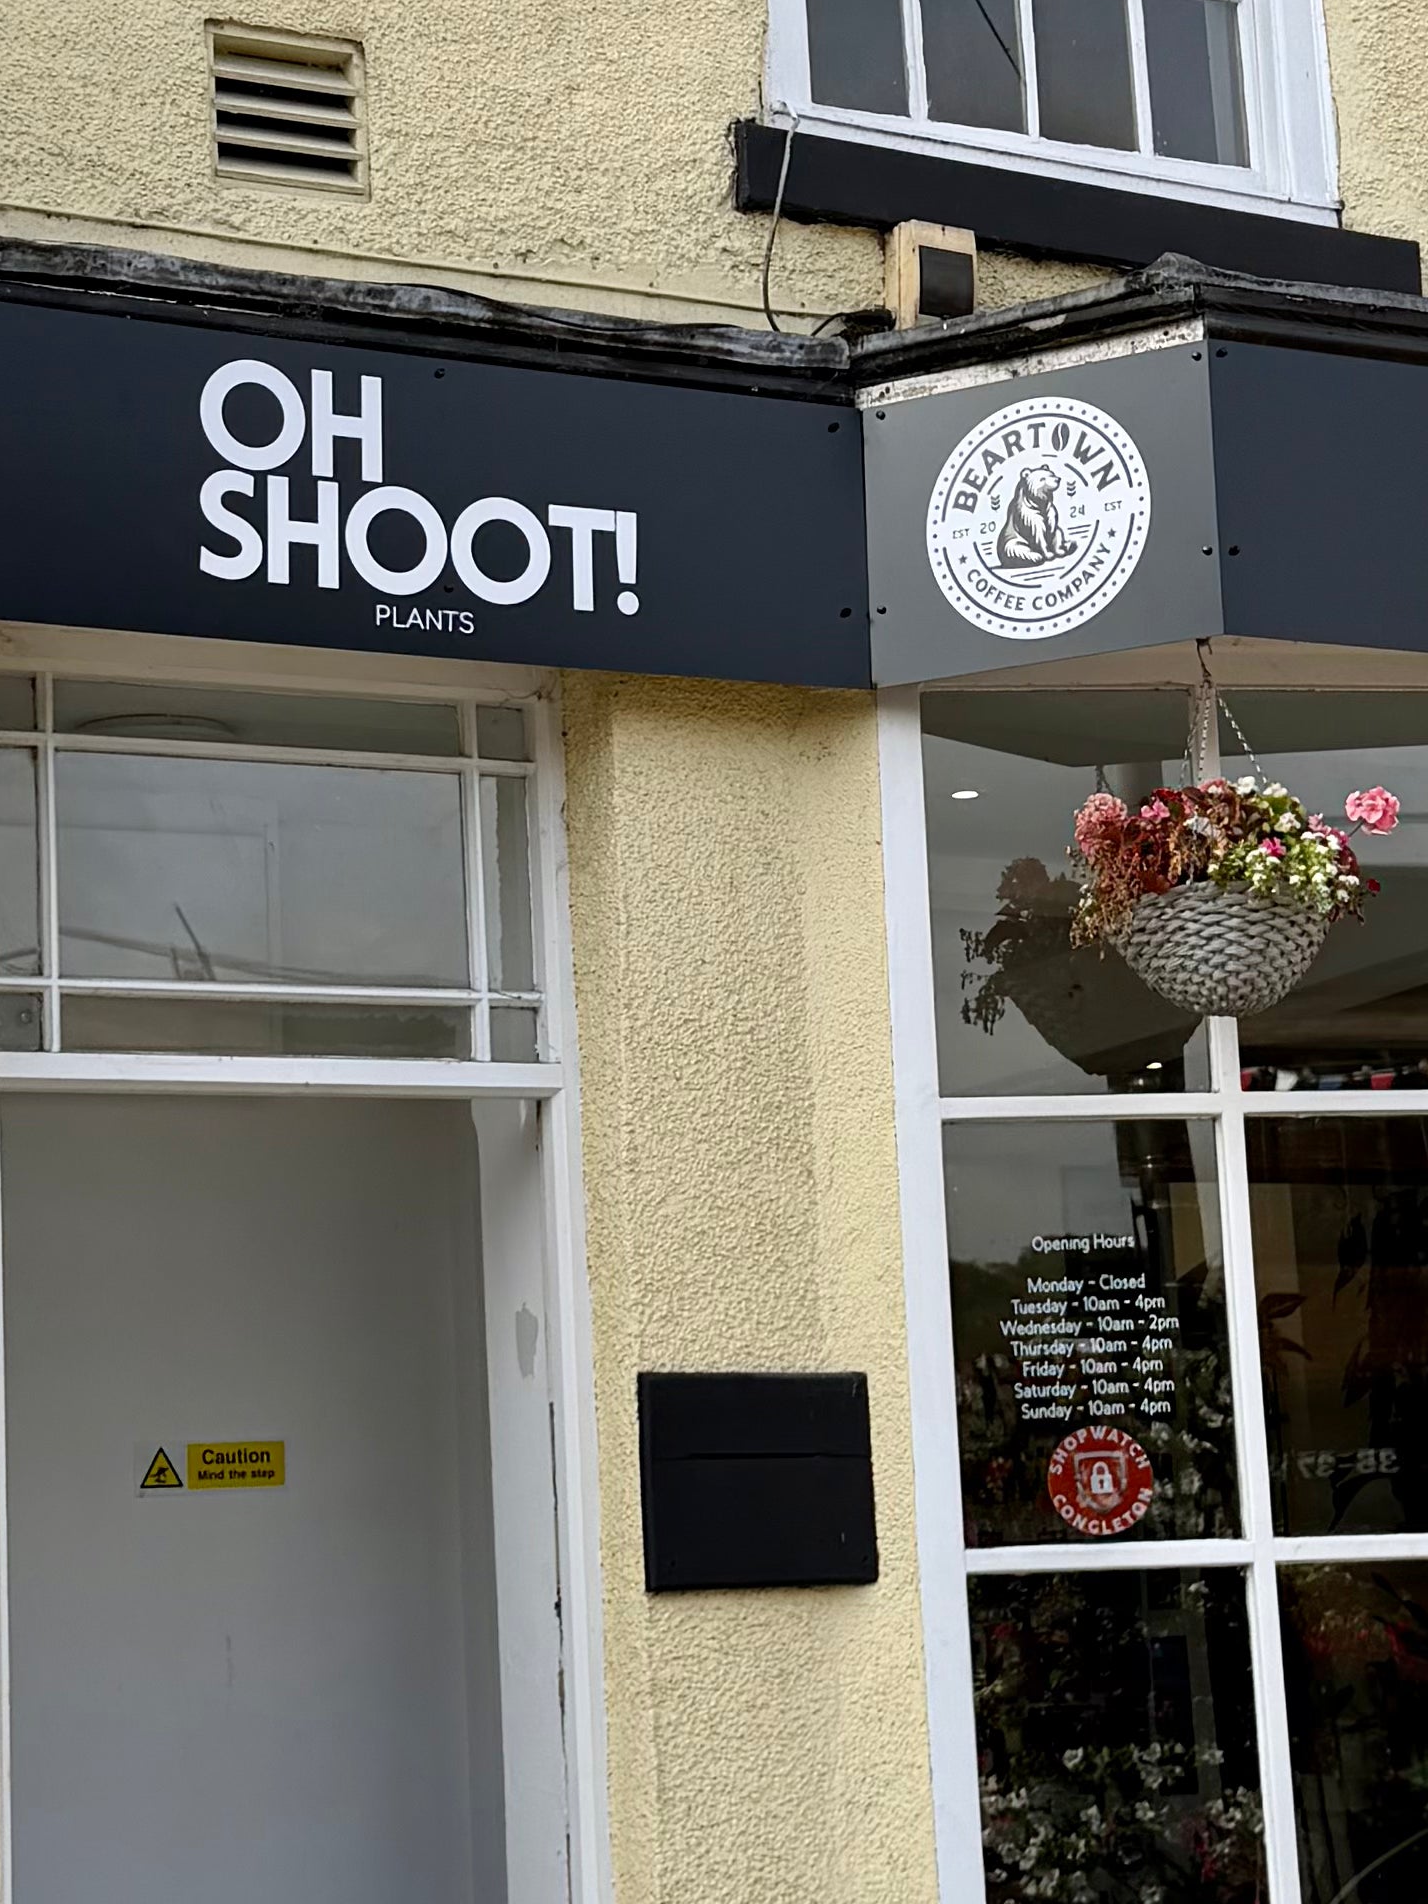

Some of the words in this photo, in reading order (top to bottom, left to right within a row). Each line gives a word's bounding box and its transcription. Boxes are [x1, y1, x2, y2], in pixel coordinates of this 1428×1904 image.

[199, 359, 383, 483] OH
[952, 422, 1121, 514] BEARTOWN
[980, 521, 996, 534] 20
[1069, 504, 1086, 518] 24
[199, 469, 640, 616] SHOOT!
[967, 568, 1025, 611] COFFEE
[1032, 543, 1111, 611] COMPANY
[375, 603, 475, 635] PLANTS
[1031, 1235, 1090, 1254] Opening
[1093, 1233, 1135, 1249] Hours
[1027, 1277, 1084, 1295] Monday
[1099, 1274, 1146, 1291] Closed
[1010, 1298, 1067, 1316] Tuesday
[1083, 1296, 1120, 1312] 10am
[1134, 1295, 1166, 1310] 4pm
[1000, 1317, 1082, 1337] Wednesday
[1097, 1316, 1134, 1332] 10am
[1149, 1314, 1179, 1330] 2pm
[1010, 1339, 1074, 1358] Thursday
[1089, 1337, 1127, 1353] 10am
[1142, 1336, 1173, 1351] 4pm
[1022, 1360, 1065, 1379] Friday
[1080, 1359, 1117, 1374] 10am
[1132, 1357, 1164, 1373] 4pm
[1014, 1382, 1077, 1399] Saturday
[1092, 1379, 1129, 1394] 10am
[1144, 1377, 1175, 1394] 4pm
[1021, 1403, 1073, 1421] Sunday
[1088, 1399, 1125, 1416] 10am
[1140, 1399, 1171, 1415] 4pm
[201, 1447, 271, 1465] Caution
[1048, 1426, 1149, 1475] SHOPWATCH
[198, 1470, 225, 1480] Mind
[228, 1469, 247, 1479] the
[251, 1468, 275, 1480] step
[1053, 1487, 1153, 1535] CONGLETON
